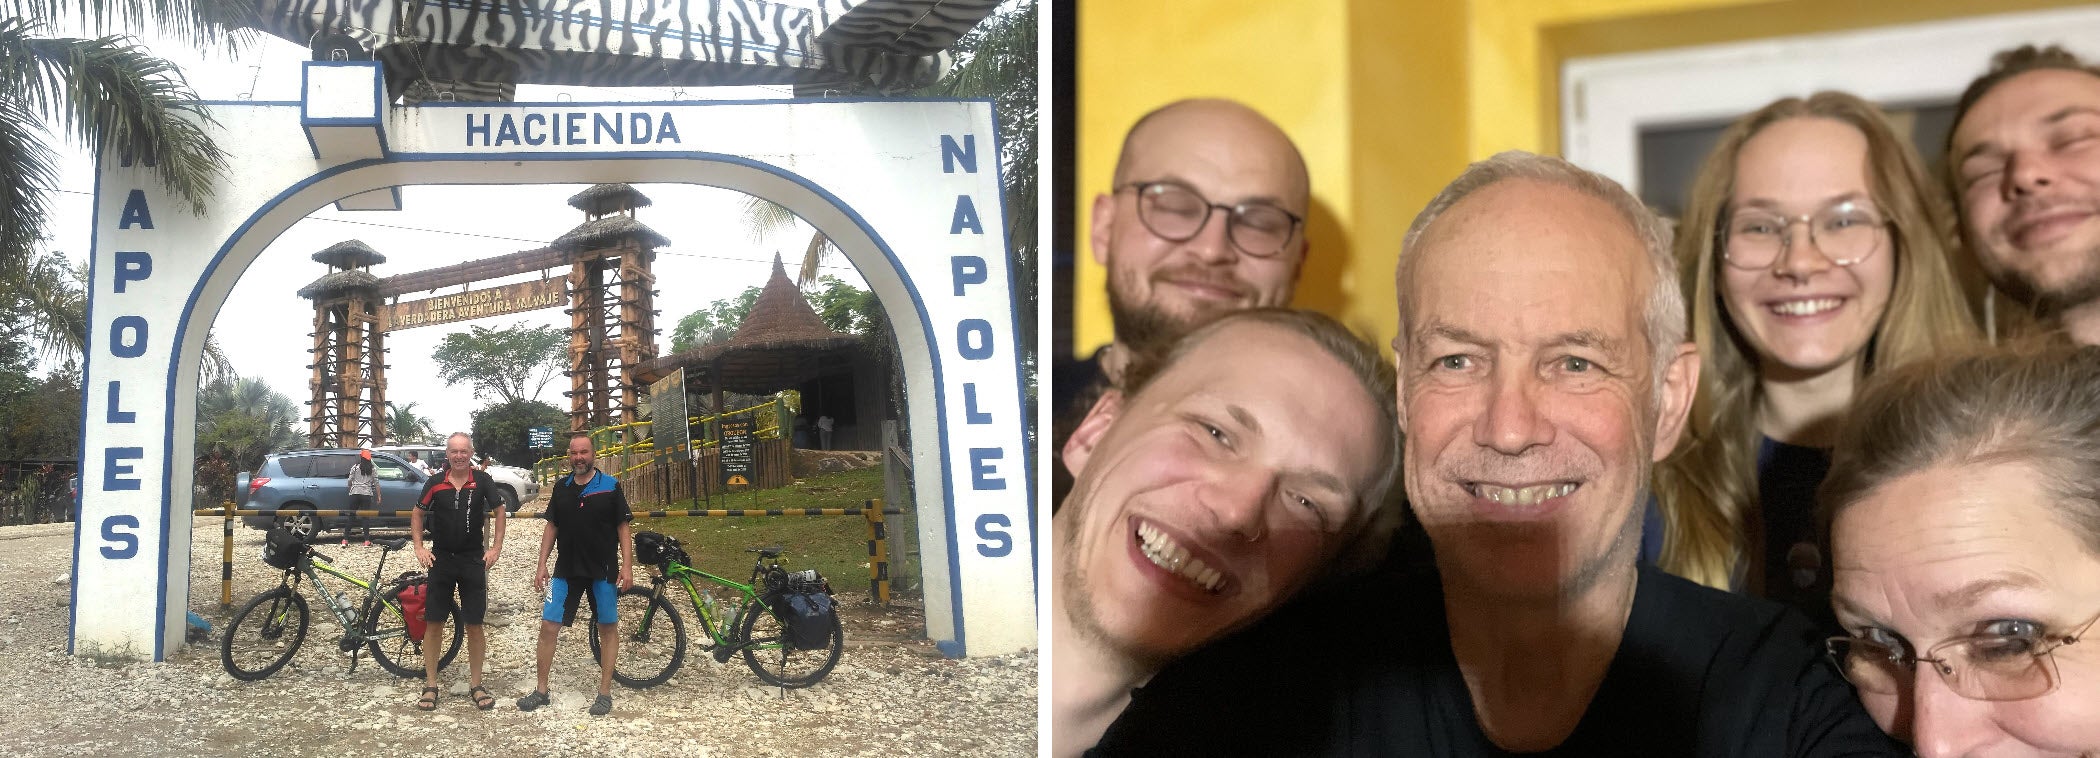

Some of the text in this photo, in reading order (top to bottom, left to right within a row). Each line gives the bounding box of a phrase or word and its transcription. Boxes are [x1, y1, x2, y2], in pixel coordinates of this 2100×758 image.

[466, 111, 682, 147] HACIENDA
[459, 299, 513, 319] AVENTURA
[942, 134, 1013, 558] NAPOLES
